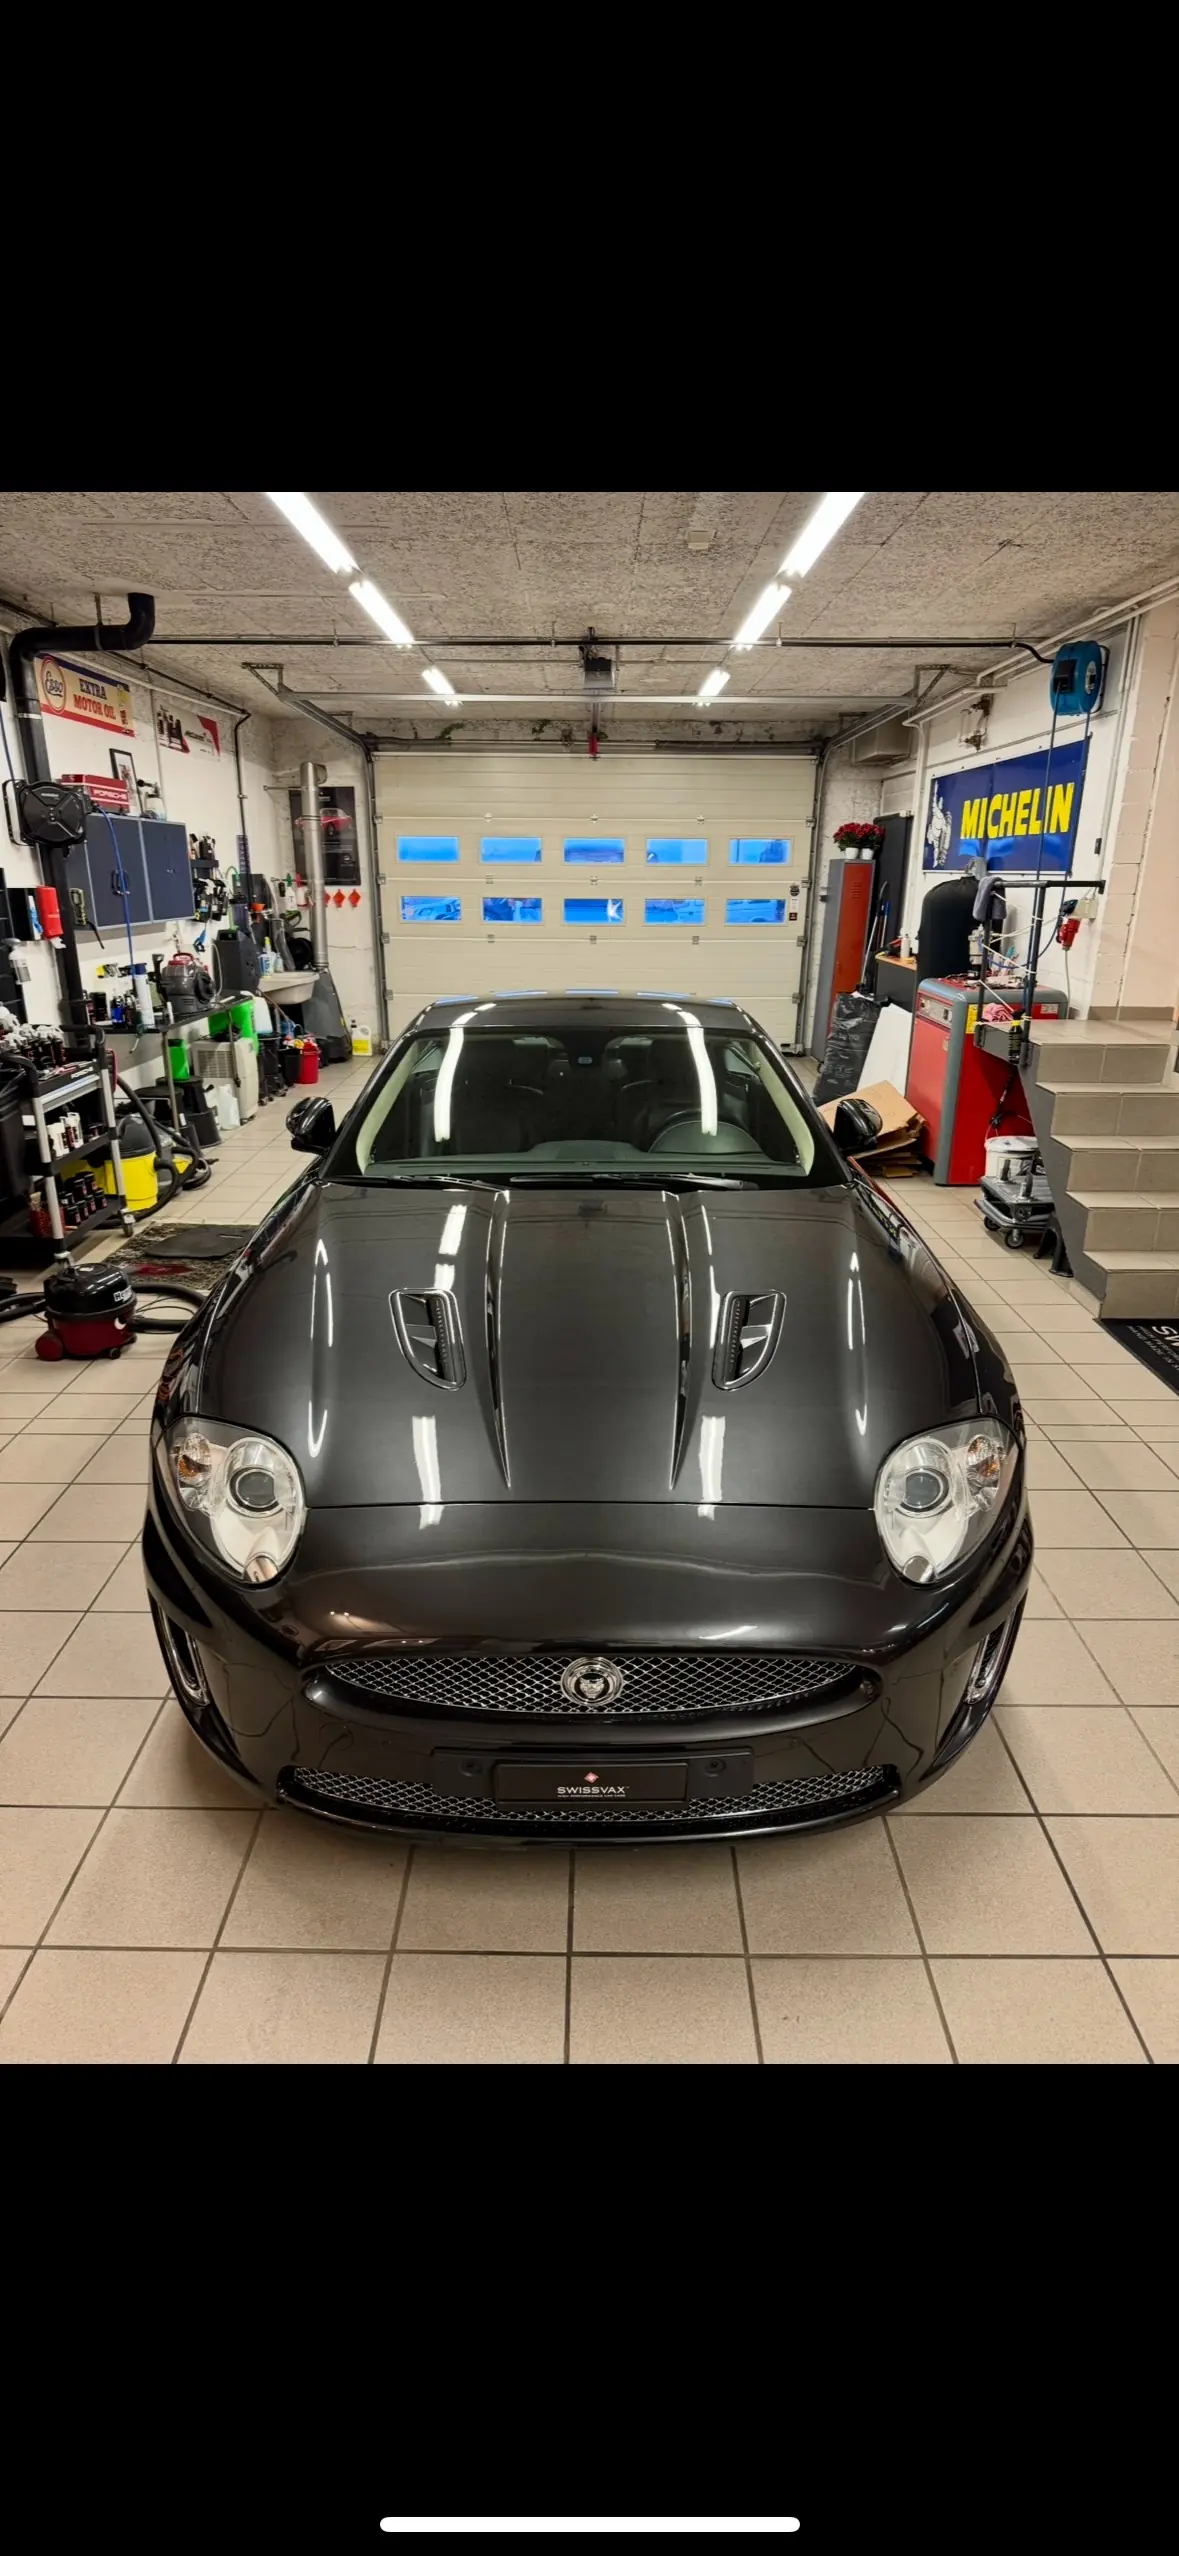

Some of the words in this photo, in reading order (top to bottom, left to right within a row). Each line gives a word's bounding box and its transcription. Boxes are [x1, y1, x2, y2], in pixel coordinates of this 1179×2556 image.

[45, 670, 63, 694] Esso
[79, 678, 107, 700] EXTRA
[73, 694, 103, 715] MOTOR
[103, 704, 116, 719] OIL
[960, 782, 1075, 839] MICHELIN
[557, 1786, 626, 1794] SWISSVAX
